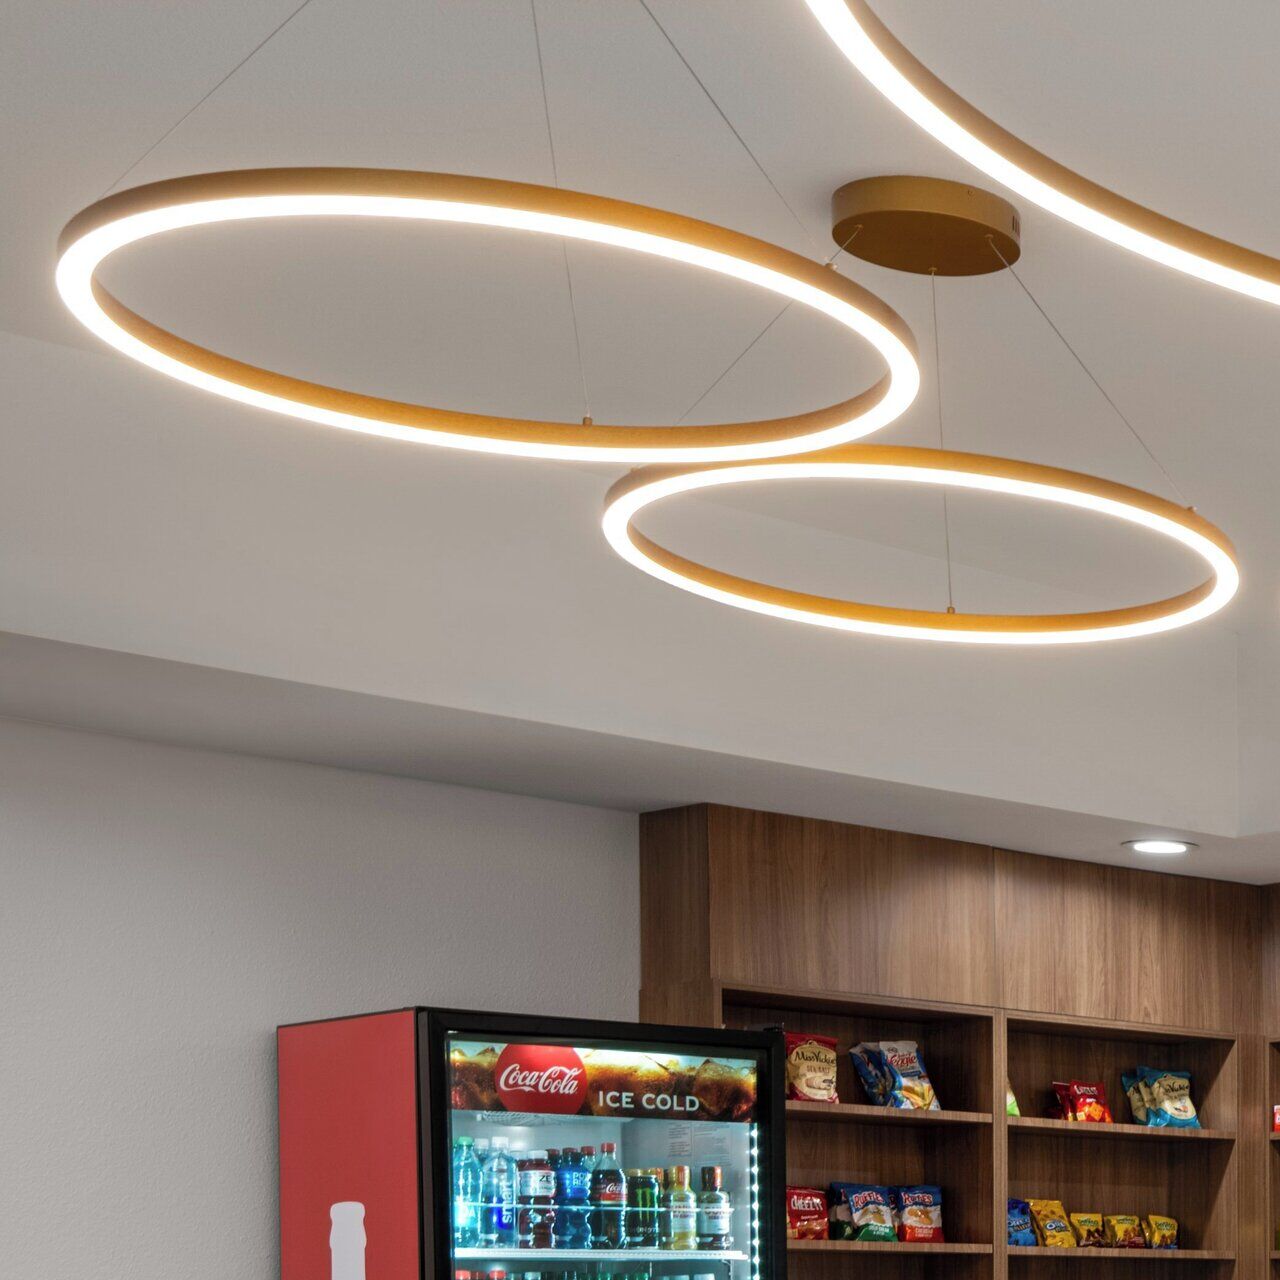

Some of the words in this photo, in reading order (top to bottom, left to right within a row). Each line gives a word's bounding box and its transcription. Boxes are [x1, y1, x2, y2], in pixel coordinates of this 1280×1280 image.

[499, 1063, 584, 1096] Coca-Cola
[598, 1090, 635, 1109] ICE
[642, 1093, 700, 1113] COLD
